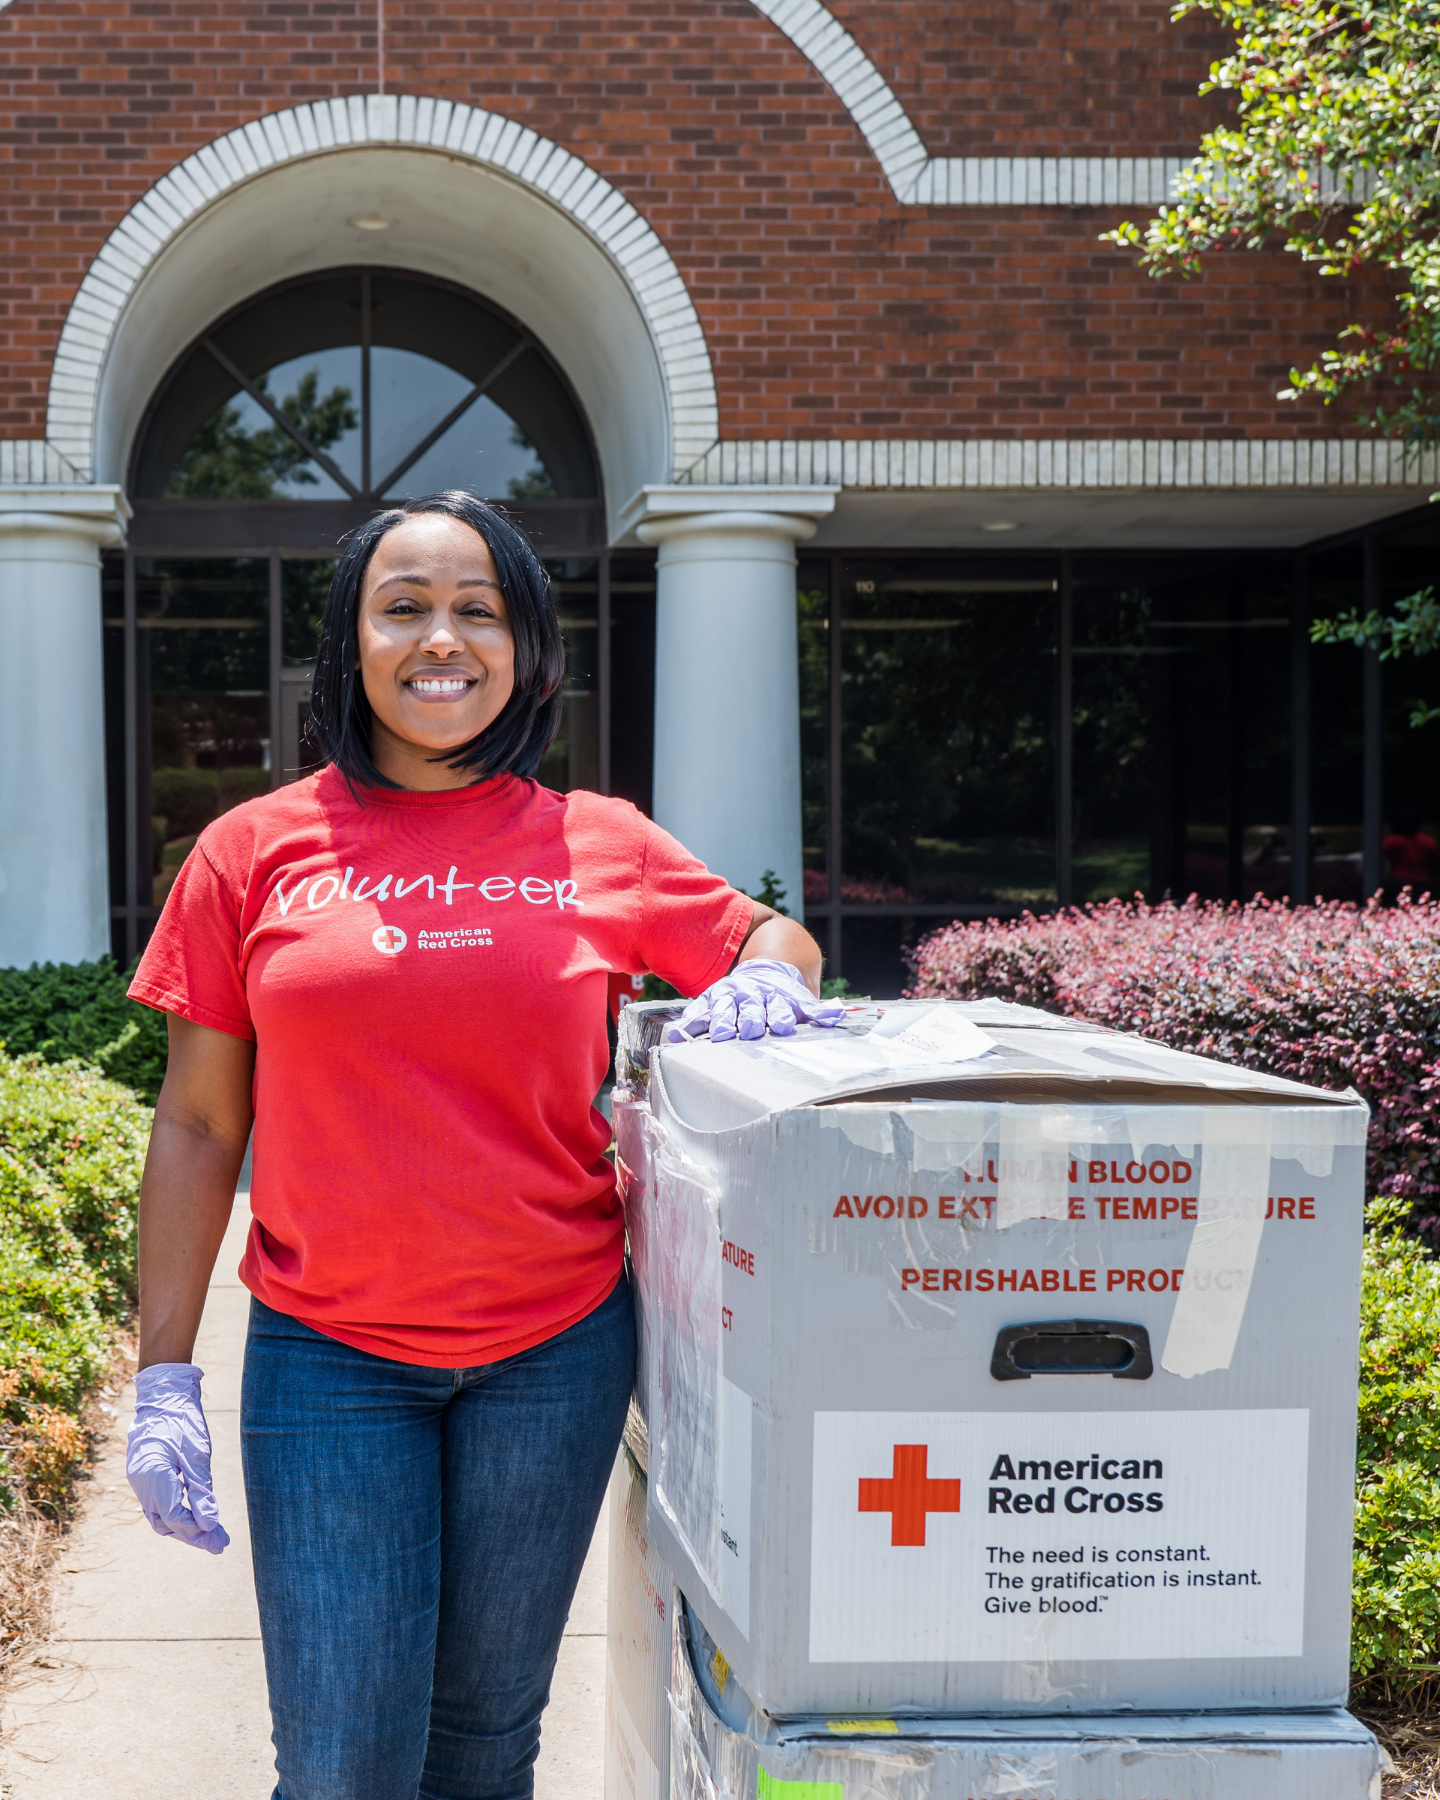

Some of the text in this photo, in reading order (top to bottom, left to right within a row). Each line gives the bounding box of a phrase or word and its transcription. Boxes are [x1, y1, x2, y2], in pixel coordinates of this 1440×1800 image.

[417, 928, 492, 939] American
[417, 938, 493, 949] Red Cross
[1089, 1160, 1192, 1184] BLOOD
[832, 1195, 929, 1220] AVOID
[901, 1268, 1097, 1291] PERISHABLE
[988, 1454, 1164, 1481] American
[988, 1486, 1164, 1514] Red Cross
[985, 1545, 1211, 1563] The need is constant.
[985, 1568, 1262, 1592] The gratification is instant.
[984, 1596, 1031, 1614] Give
